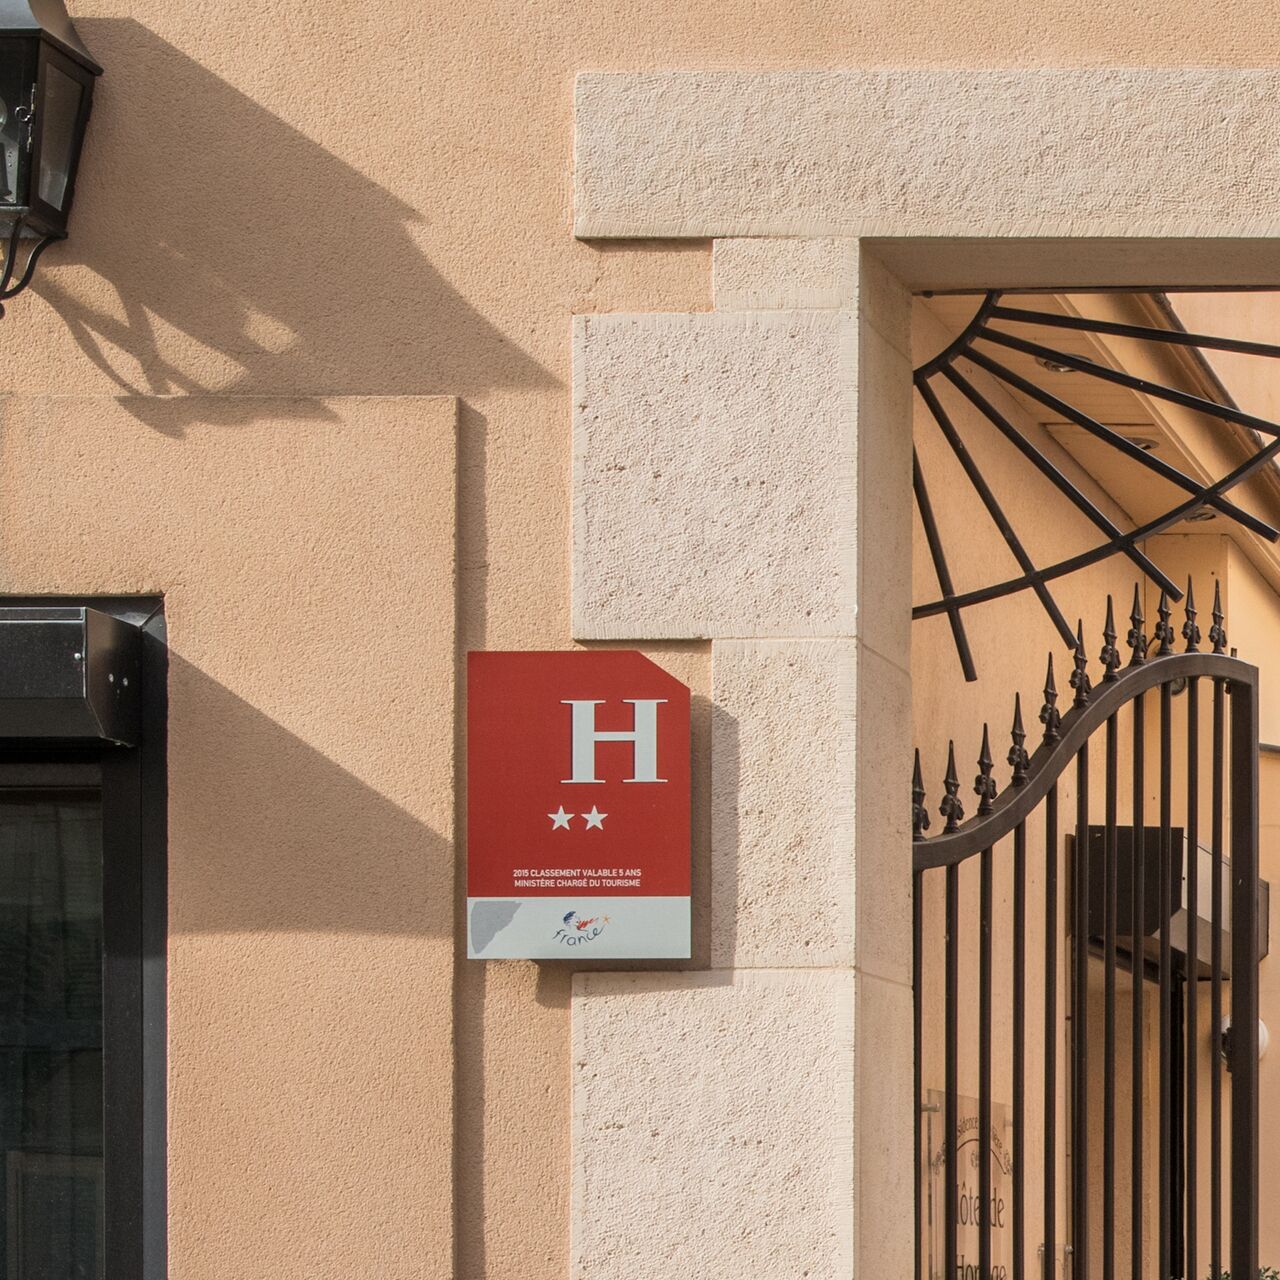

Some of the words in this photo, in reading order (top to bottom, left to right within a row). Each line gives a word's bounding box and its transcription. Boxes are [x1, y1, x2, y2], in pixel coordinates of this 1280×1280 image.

[560, 699, 669, 783] H
[513, 869, 529, 877] 2015
[530, 869, 581, 877] CLASSEMENT
[582, 869, 617, 877] VALABLE
[618, 869, 624, 877] 5
[625, 869, 642, 877] ANS
[514, 878, 555, 887] MINISTÈRE
[556, 878, 588, 887] CHARGÉ
[589, 879, 601, 887] DU
[602, 879, 641, 887] TOURISME
[990, 1187, 1005, 1228] de
